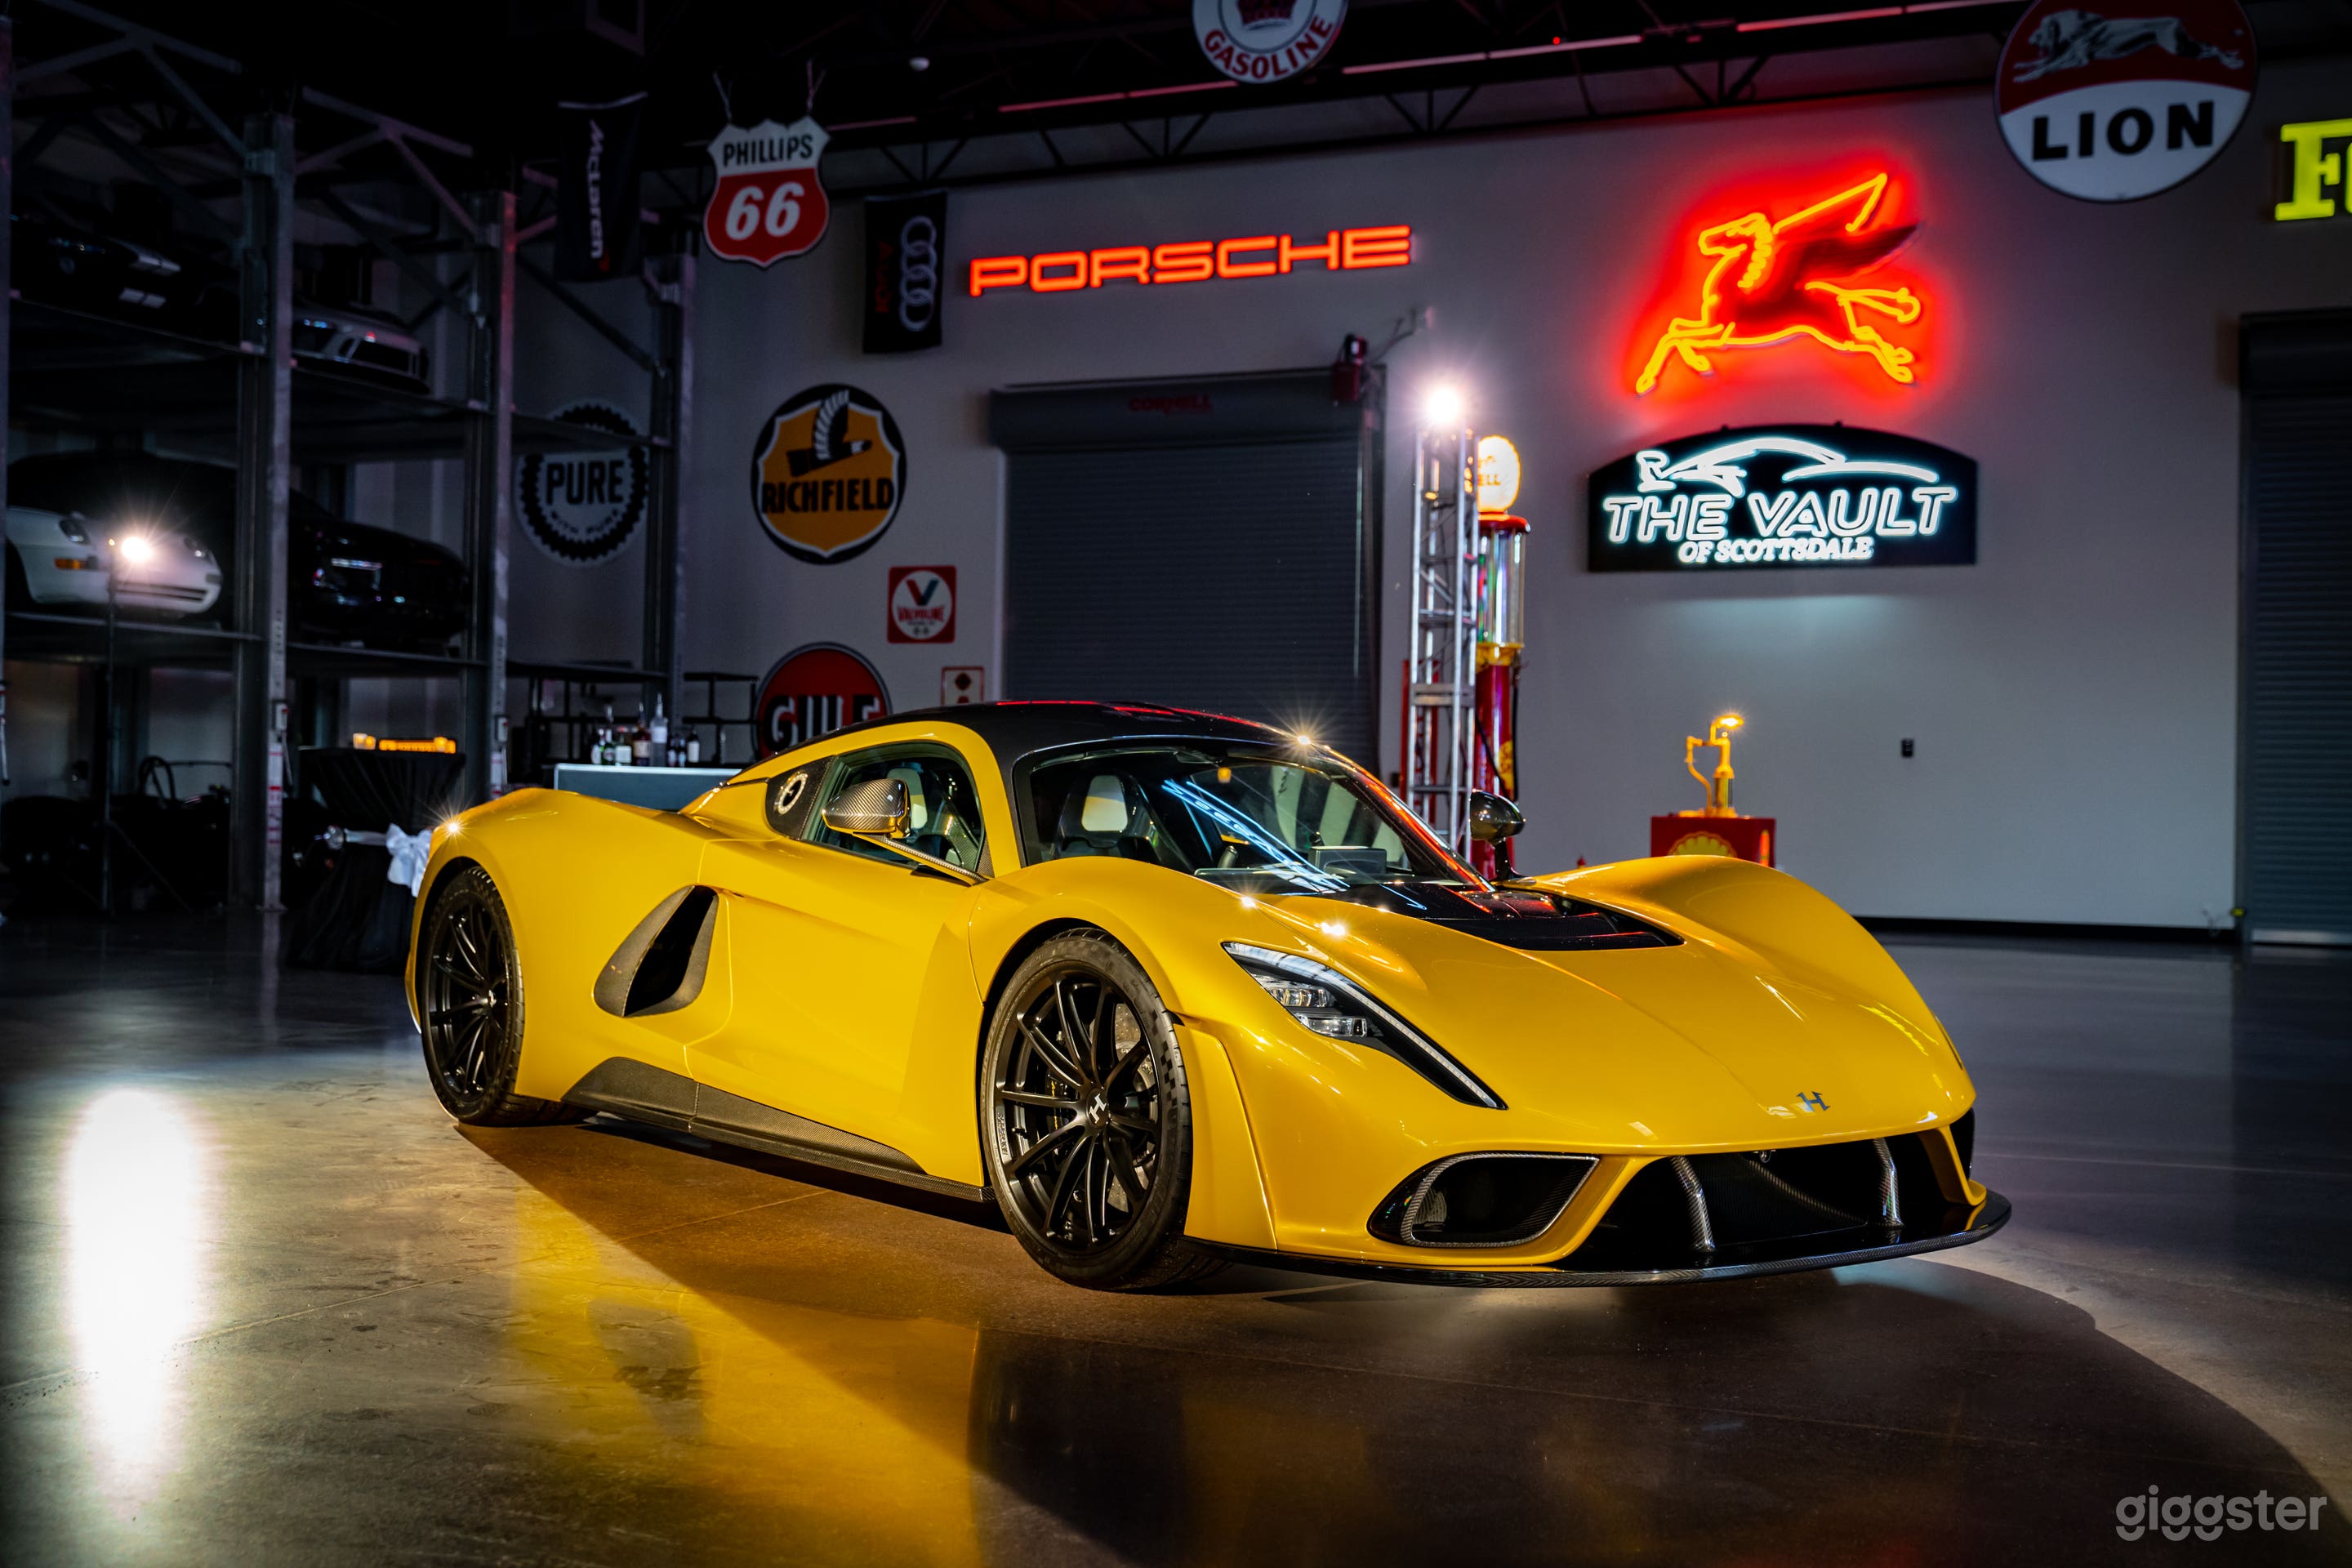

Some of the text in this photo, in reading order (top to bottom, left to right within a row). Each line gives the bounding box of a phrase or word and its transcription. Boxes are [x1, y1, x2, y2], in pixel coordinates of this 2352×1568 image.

[1205, 16, 1333, 78] GASOLINE
[724, 135, 813, 167] PHILLIPS
[2032, 100, 2215, 161] LION
[2274, 118, 2352, 221] F
[725, 181, 805, 241] 66
[969, 225, 1410, 297] PORSCHE
[547, 461, 624, 505] PURE
[761, 478, 895, 514] RICHFIELD
[1603, 487, 1958, 543] THE VAULT
[1677, 537, 1874, 564] OF SCOTTSDALE
